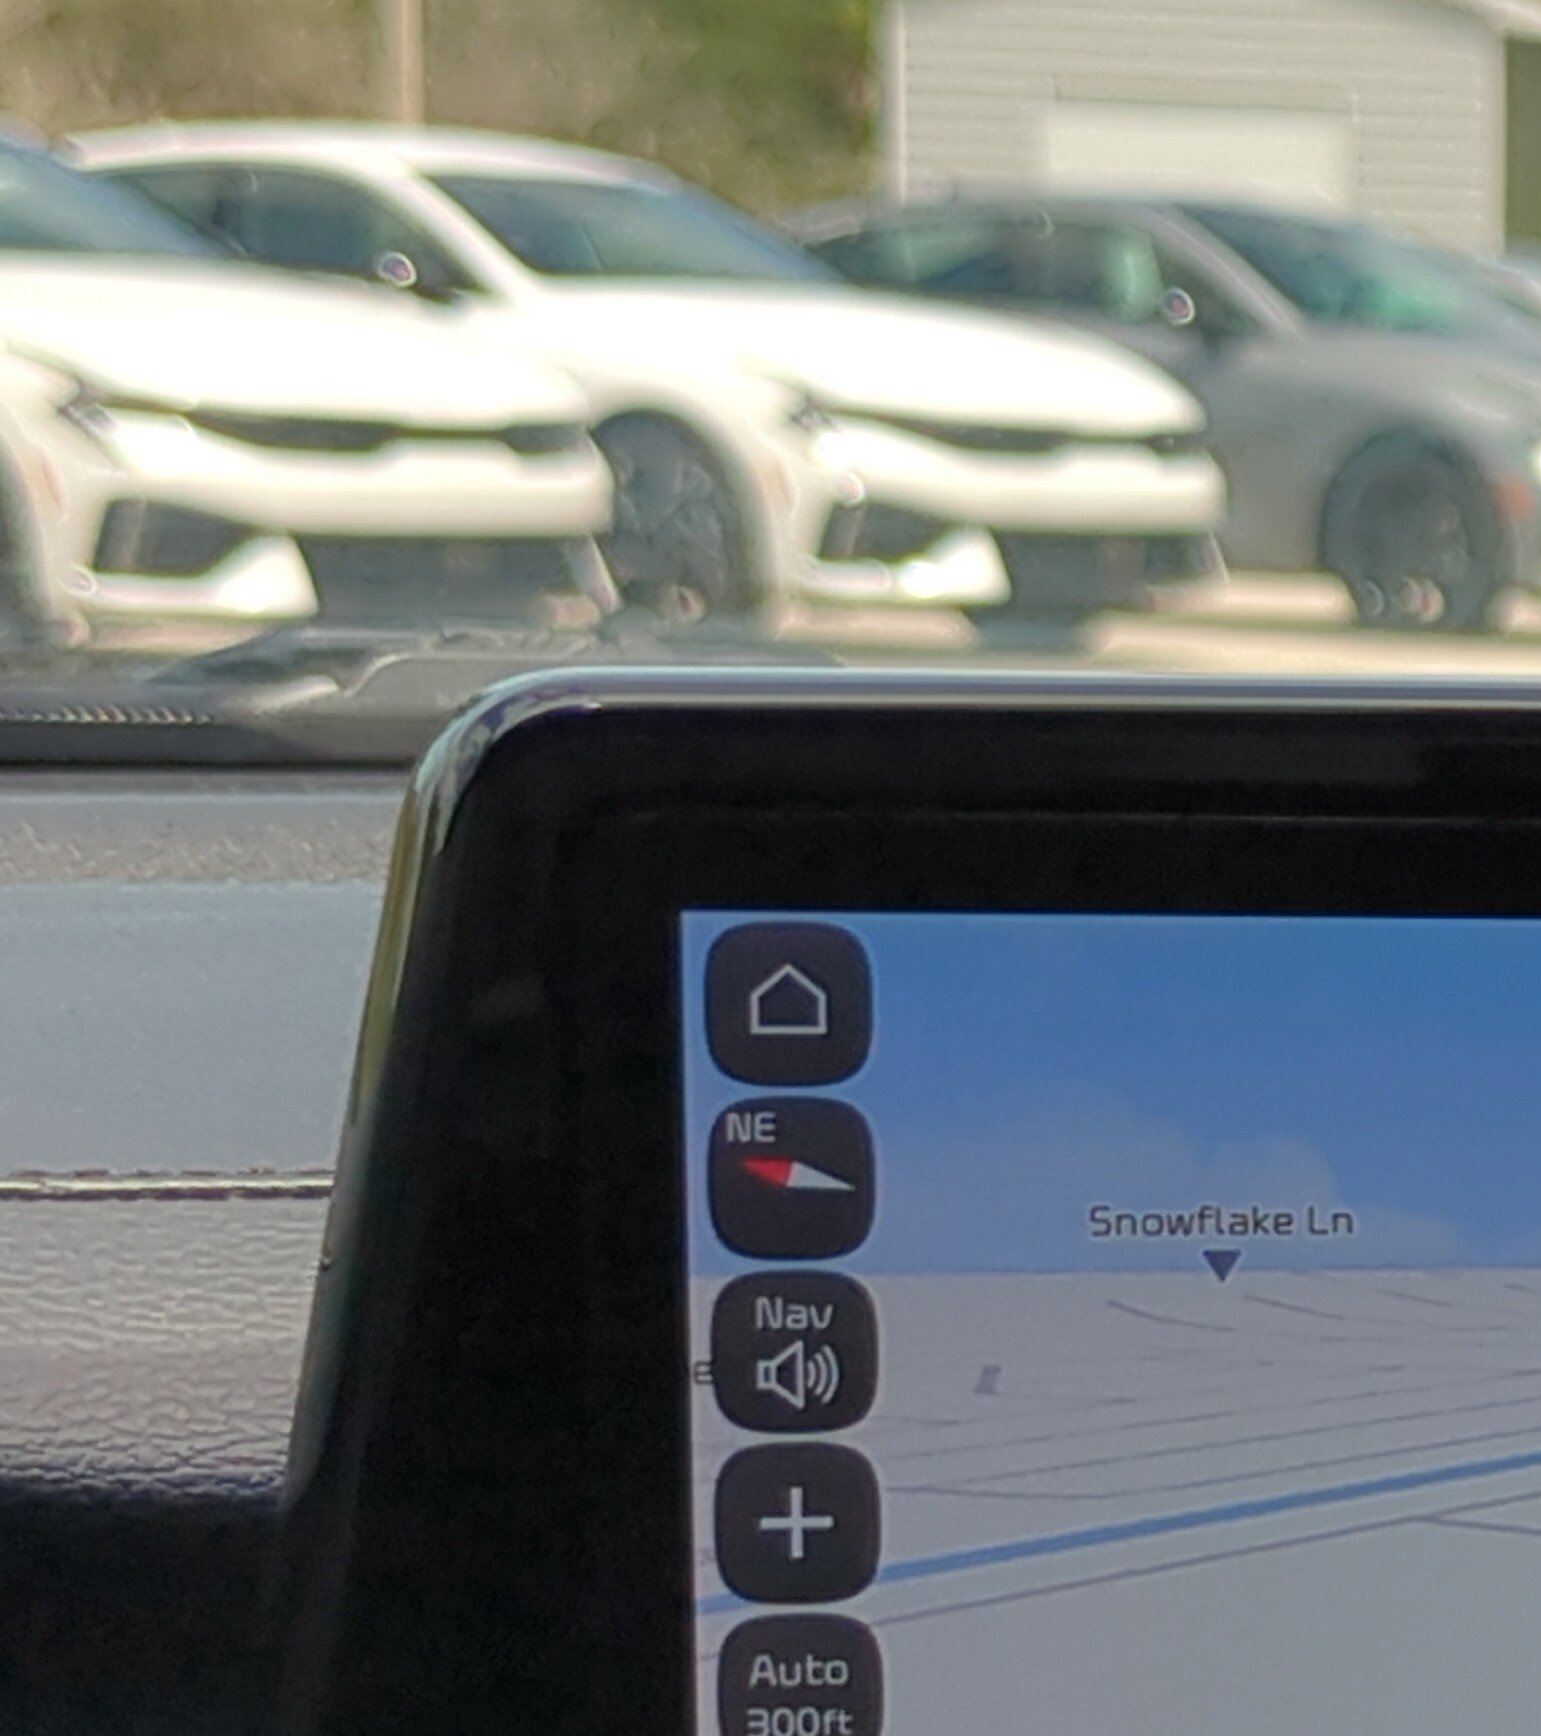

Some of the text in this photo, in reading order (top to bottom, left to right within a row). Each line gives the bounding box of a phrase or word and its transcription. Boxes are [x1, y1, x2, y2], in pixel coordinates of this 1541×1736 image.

[726, 1112, 776, 1143] NE
[1089, 1206, 1354, 1237] Snowflake Ln
[755, 1297, 832, 1330] Nav
[750, 1654, 848, 1687] Auto
